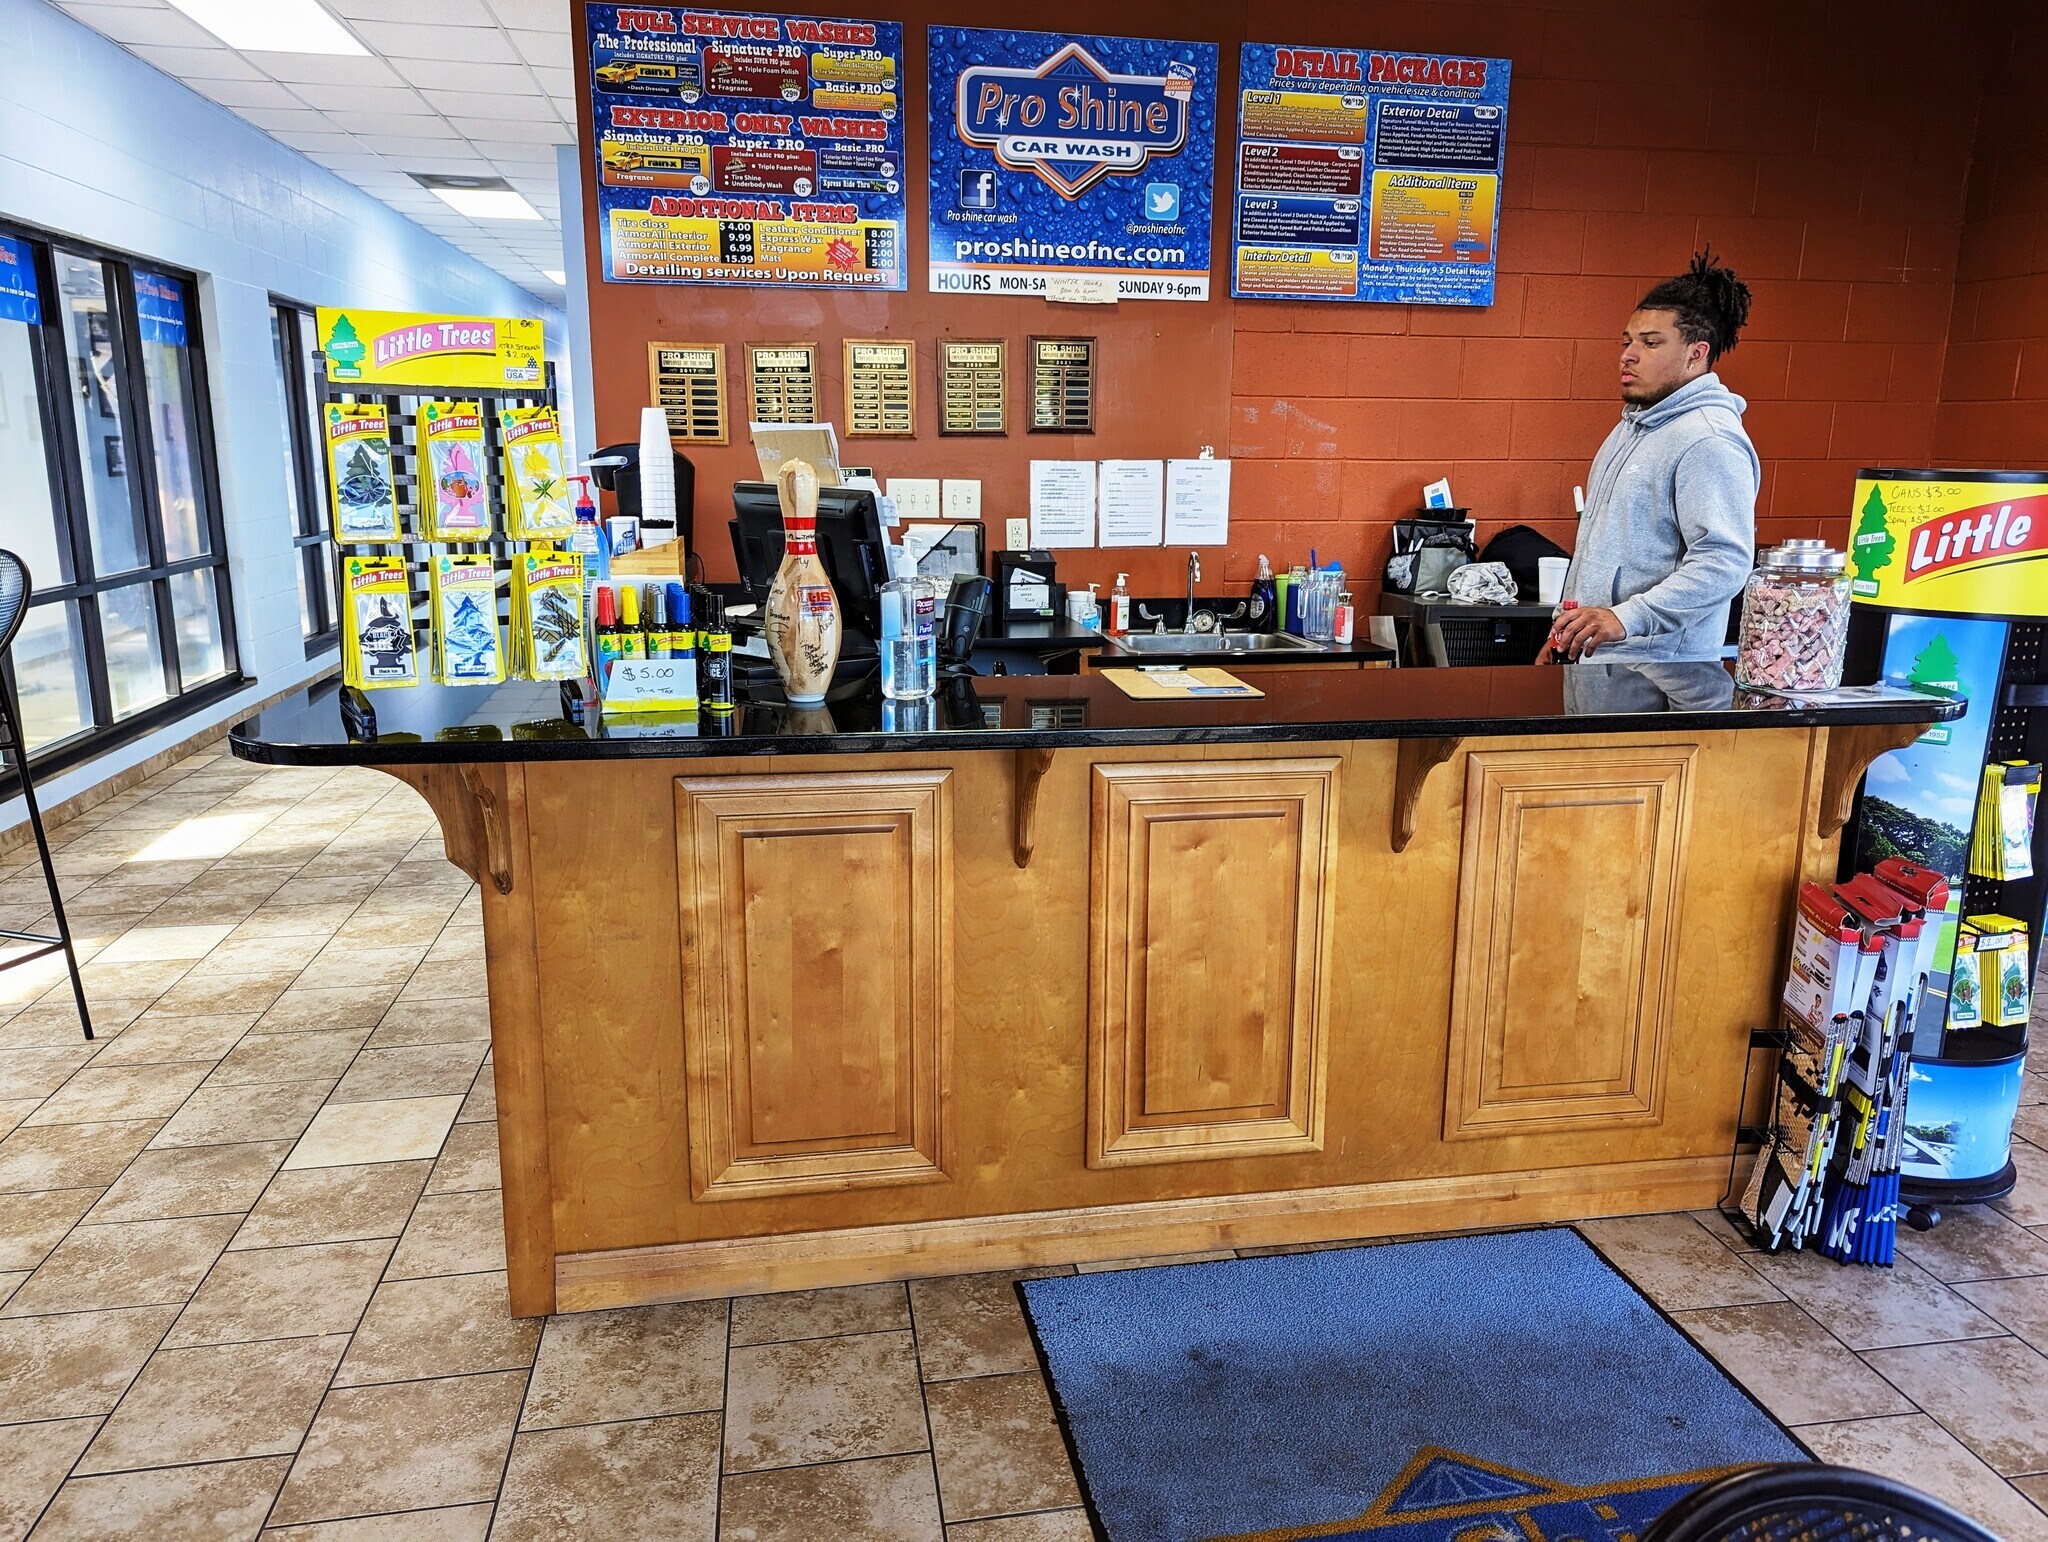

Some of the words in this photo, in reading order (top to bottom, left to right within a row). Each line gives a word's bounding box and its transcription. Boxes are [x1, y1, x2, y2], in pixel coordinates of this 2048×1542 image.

[618, 10, 676, 33] FULL
[682, 13, 779, 40] SERVICE
[786, 20, 876, 46] WASHES
[597, 34, 619, 49] The
[624, 35, 696, 54] Professional
[712, 40, 773, 58] Signature
[778, 45, 802, 58] PRO
[823, 47, 855, 61] Super
[860, 50, 882, 60] PRO
[745, 66, 762, 74] Triple
[1174, 65, 1192, 78] 24-Hour
[1275, 48, 1362, 81] DETAIL
[1369, 54, 1488, 88] PACKAGES
[718, 84, 753, 92] Fragrance
[825, 82, 855, 93] Basic
[860, 83, 881, 94] PRO
[1269, 78, 1295, 88] Prices
[1297, 80, 1316, 91] vary
[1318, 81, 1365, 94] depending
[1382, 85, 1412, 95] vehicle
[1413, 87, 1429, 96] size
[1440, 88, 1480, 99] condition
[1247, 92, 1273, 104] Level
[1275, 94, 1280, 104] 1
[976, 82, 1045, 127] Pro
[1058, 84, 1170, 134] Shine
[1382, 104, 1425, 117] Exterior
[1426, 107, 1460, 119] Detail
[611, 106, 729, 132] EXTERIOR
[735, 113, 792, 136] ONLY
[800, 116, 887, 141] WASHES
[604, 130, 671, 145] Signature
[677, 134, 703, 146] PRO
[729, 136, 770, 151] Super
[777, 139, 805, 151] PRO
[835, 143, 863, 152] Basic
[865, 144, 885, 153] PRO
[1012, 141, 1059, 154] CAR
[1065, 143, 1131, 157] WASH
[1245, 146, 1270, 156] Level
[1272, 148, 1279, 157] 2
[617, 173, 654, 181] Fragrance
[823, 179, 841, 188] Xpress
[1389, 175, 1445, 189] Additional
[1447, 178, 1477, 190] Items
[650, 196, 783, 220] ADDITIONAL
[791, 203, 858, 223] ITEMS
[1245, 199, 1270, 209] Level
[1271, 200, 1278, 209] 3
[617, 218, 638, 228] Tire
[639, 220, 669, 229] Gloss
[947, 211, 960, 221] Pro
[962, 211, 983, 222] shine
[984, 214, 997, 223] car
[998, 212, 1018, 224] wash
[719, 222, 725, 231] $
[728, 223, 751, 231] 4.00
[759, 225, 798, 233] Leather
[801, 226, 862, 236] Conditioner
[1126, 223, 1186, 235] @proshineofnc
[617, 229, 665, 239] ArmorAll
[668, 232, 708, 240] Interior
[729, 233, 751, 242] 9.99
[760, 234, 799, 244] Express
[801, 236, 823, 244] Wax
[871, 230, 893, 238] 8.00
[617, 240, 666, 249] ArmorAll
[668, 242, 711, 251] Exterior
[729, 244, 752, 252] 6.99
[760, 244, 812, 254] Fragrance
[866, 240, 892, 248] 12.99
[956, 238, 1185, 263] proshineofnc.com
[619, 250, 667, 261] ArmorAll
[669, 253, 720, 263] Complete
[725, 255, 754, 263] 15.99
[760, 254, 782, 263] Mats
[872, 259, 893, 267] 5.00
[1243, 250, 1280, 262] Interior
[1282, 252, 1311, 263] Detail
[626, 263, 702, 278] Detailing
[707, 266, 772, 279] services
[776, 269, 819, 281] Upon
[823, 270, 888, 284] Request
[1362, 264, 1430, 275] Monday-Thursday
[1445, 266, 1468, 275] Detail
[1470, 267, 1491, 276] Hours
[938, 273, 991, 290] HOURS
[1000, 277, 1047, 290] MON-SA
[1118, 281, 1163, 294] SUNDAY
[1166, 283, 1201, 296] 9-6pm
[377, 327, 432, 362] Little
[437, 324, 492, 347] Trees
[332, 421, 358, 436] Little
[358, 420, 384, 430] Trees
[429, 420, 452, 434] Little
[456, 418, 478, 428] Trees
[507, 426, 529, 441] Little
[531, 420, 552, 432] Trees
[1888, 501, 1914, 513] TREES:
[1858, 535, 1870, 545] Little
[1870, 534, 1884, 543] Trees
[1910, 505, 2032, 572] Little
[353, 574, 377, 590] Little
[379, 571, 403, 582] Trees
[441, 572, 465, 588] Little
[467, 570, 491, 580] Trees
[528, 571, 550, 585] Little
[552, 567, 574, 578] Trees
[808, 591, 831, 602] US
